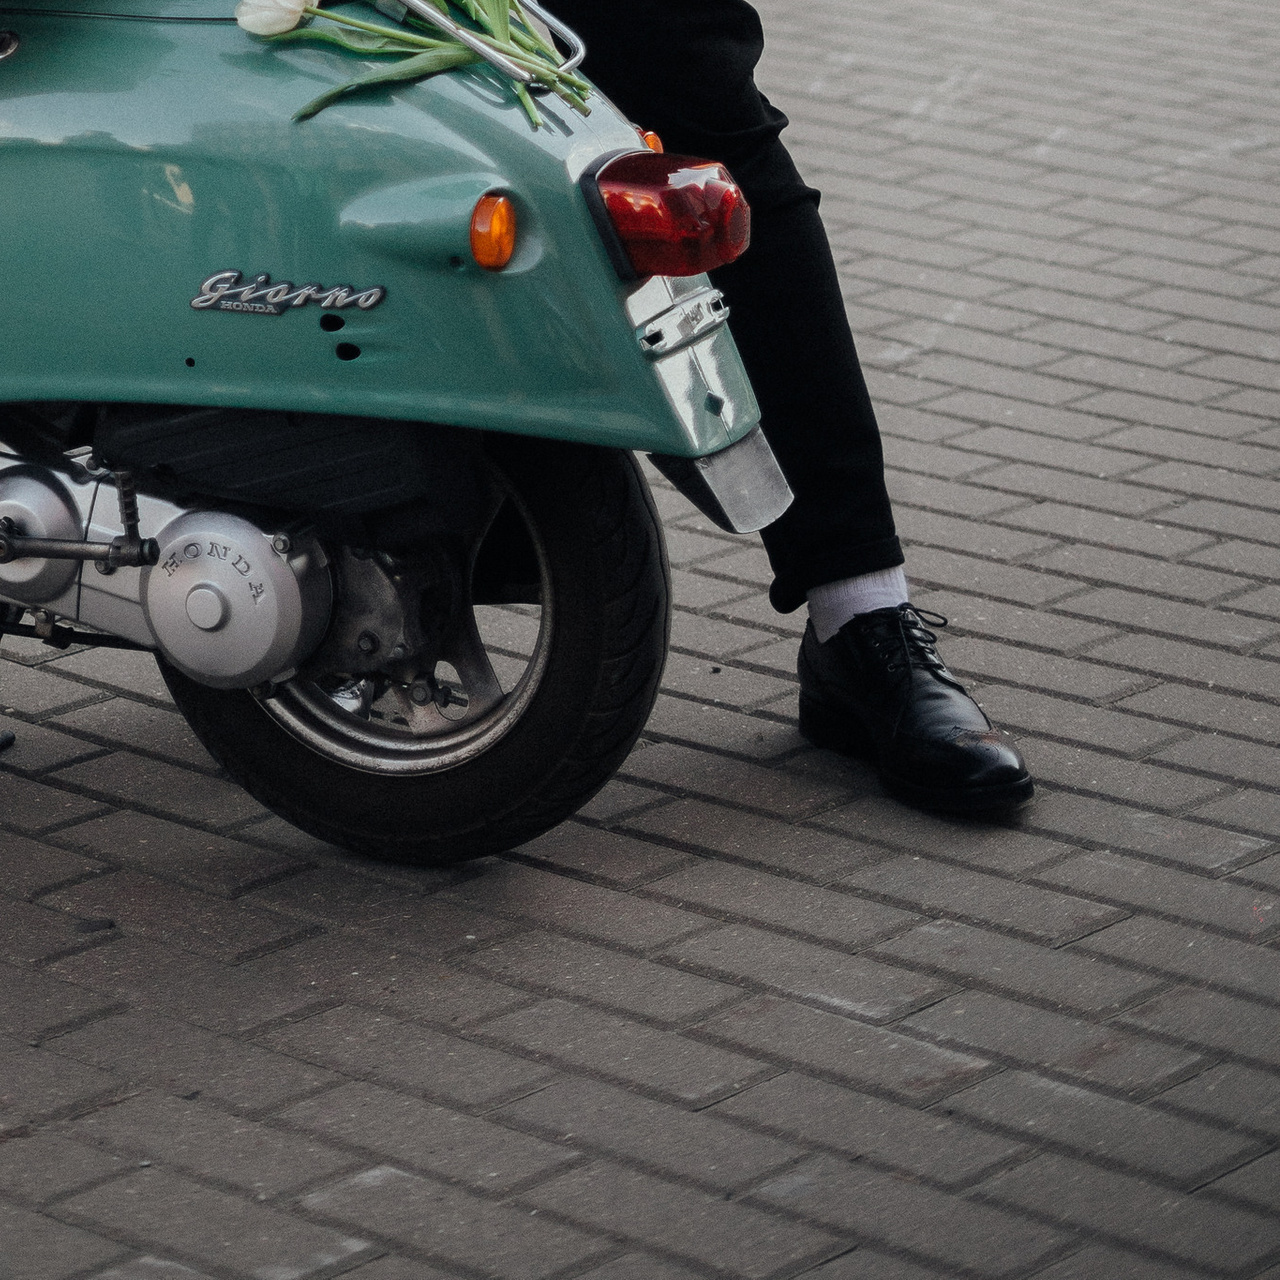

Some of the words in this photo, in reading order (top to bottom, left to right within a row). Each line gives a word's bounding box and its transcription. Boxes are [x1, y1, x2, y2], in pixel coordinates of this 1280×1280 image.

[191, 271, 380, 309] Giorno
[219, 300, 278, 314] HONDA
[161, 541, 265, 606] HONDA
